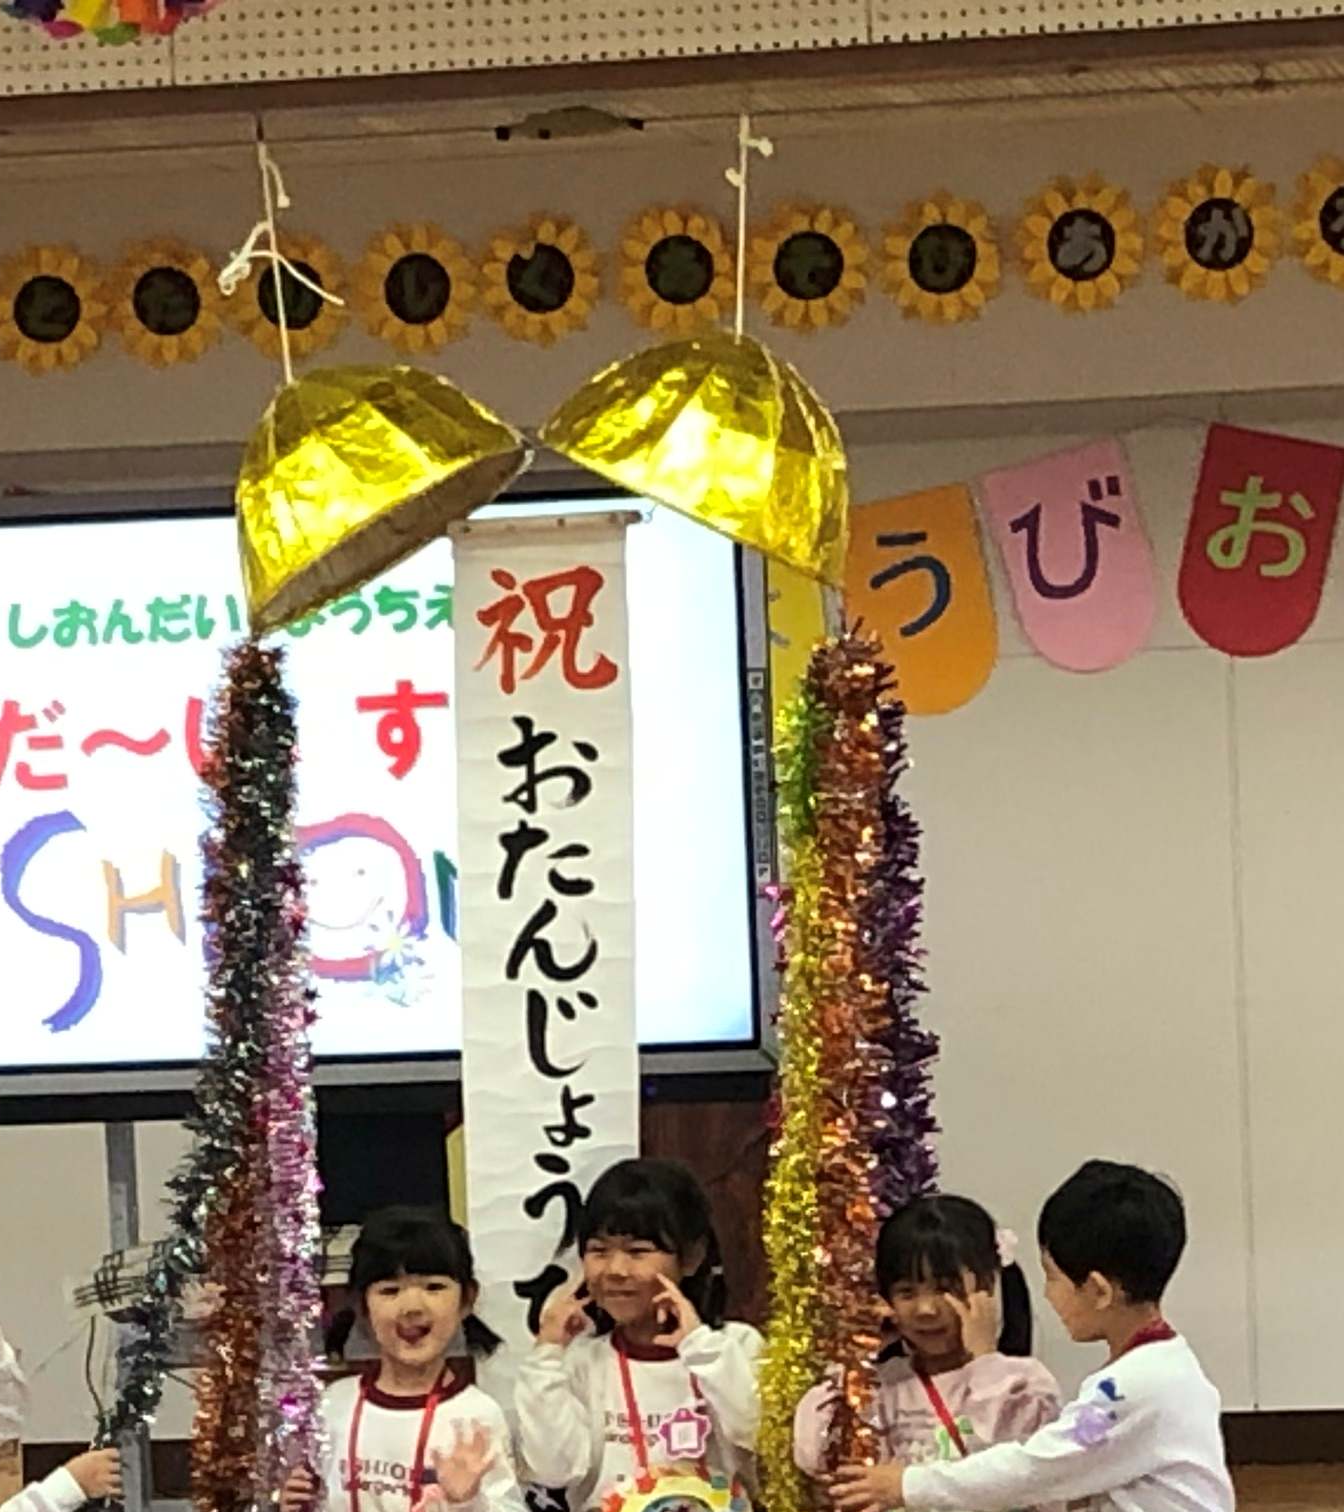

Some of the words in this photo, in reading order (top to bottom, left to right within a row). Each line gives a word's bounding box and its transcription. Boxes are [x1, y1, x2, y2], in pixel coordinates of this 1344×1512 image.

[8, 585, 455, 648] しおんだいょうちえ
[473, 564, 620, 695] 祝
[0, 809, 457, 1034] SHO
